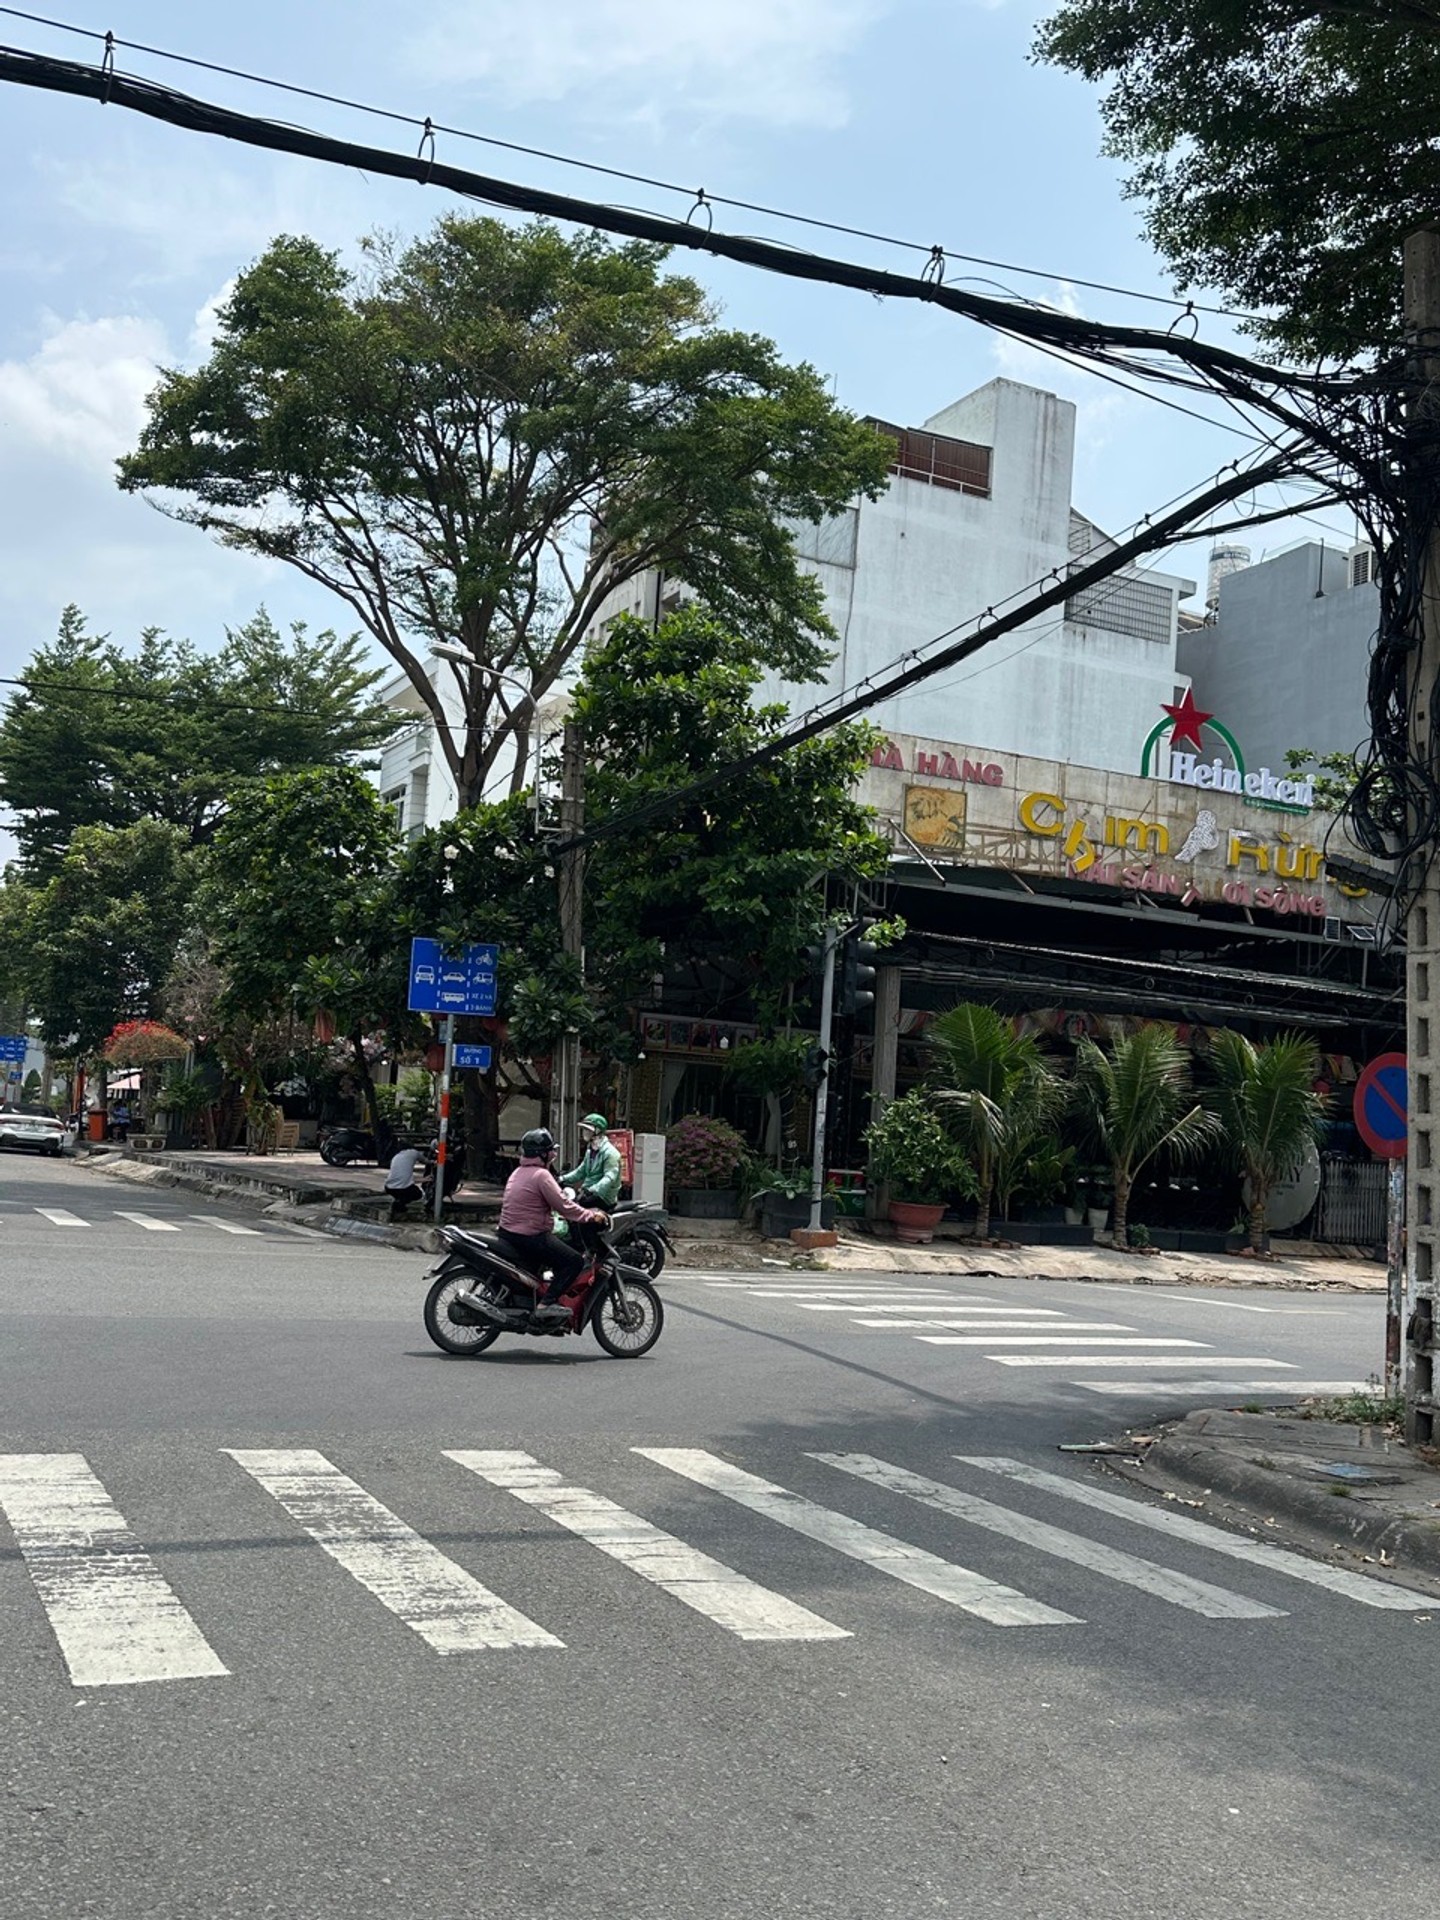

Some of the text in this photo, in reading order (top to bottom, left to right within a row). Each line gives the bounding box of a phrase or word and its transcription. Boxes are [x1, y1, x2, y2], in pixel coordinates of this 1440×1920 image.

[918, 751, 1004, 787] HÀNG
[1171, 751, 1317, 807] Heineken
[1121, 862, 1180, 896] SẢN
[1255, 881, 1327, 917] SỐNG
[460, 1055, 471, 1065] SỐ
